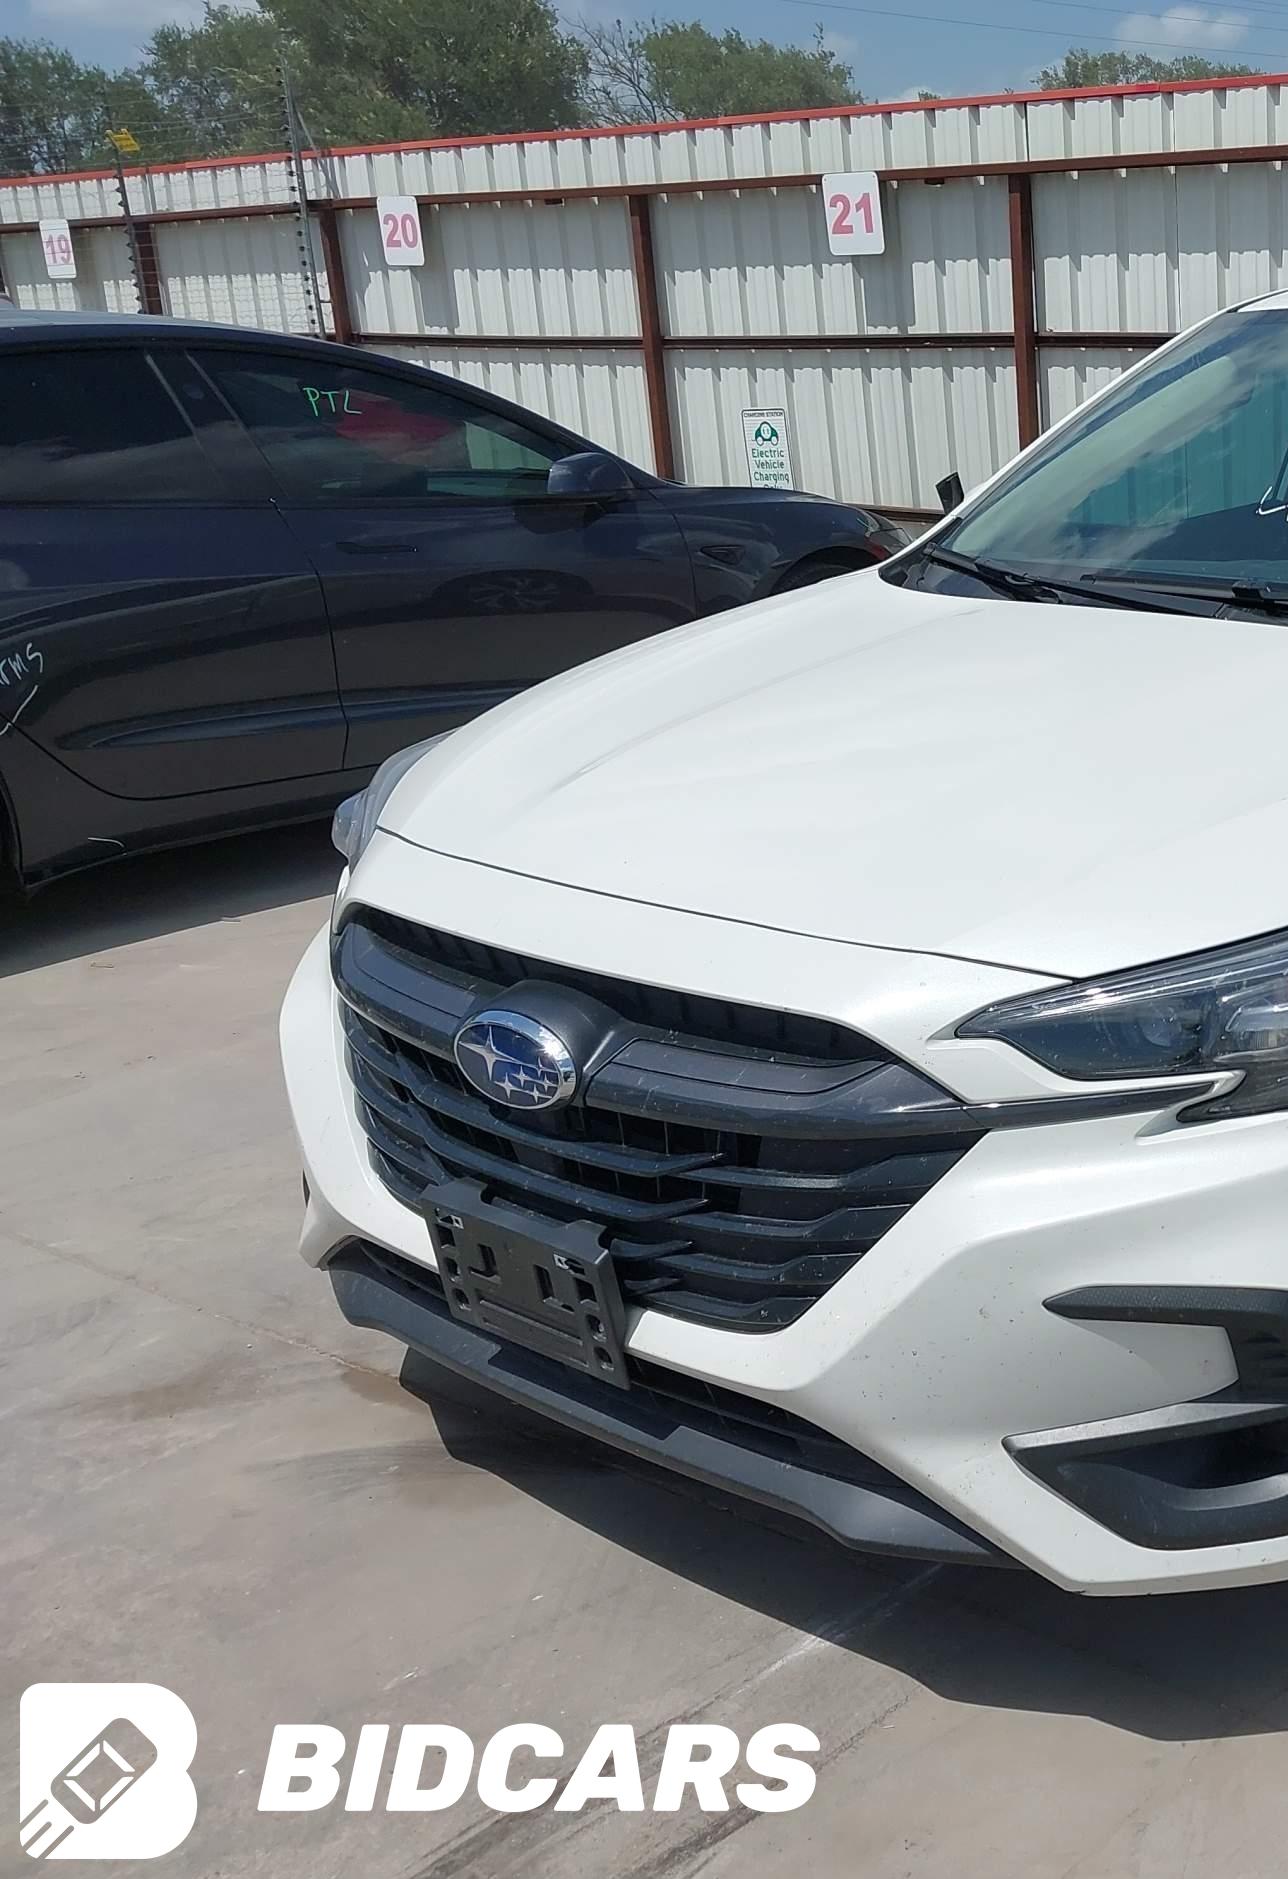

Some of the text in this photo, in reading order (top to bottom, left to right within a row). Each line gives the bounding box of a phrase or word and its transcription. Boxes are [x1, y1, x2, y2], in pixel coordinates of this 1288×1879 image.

[829, 192, 874, 235] 21
[383, 213, 418, 248] 20
[46, 234, 72, 264] 19
[302, 387, 362, 416] PTL
[751, 448, 785, 458] Electric
[754, 460, 785, 469] Vehicle
[753, 472, 789, 484] Charging
